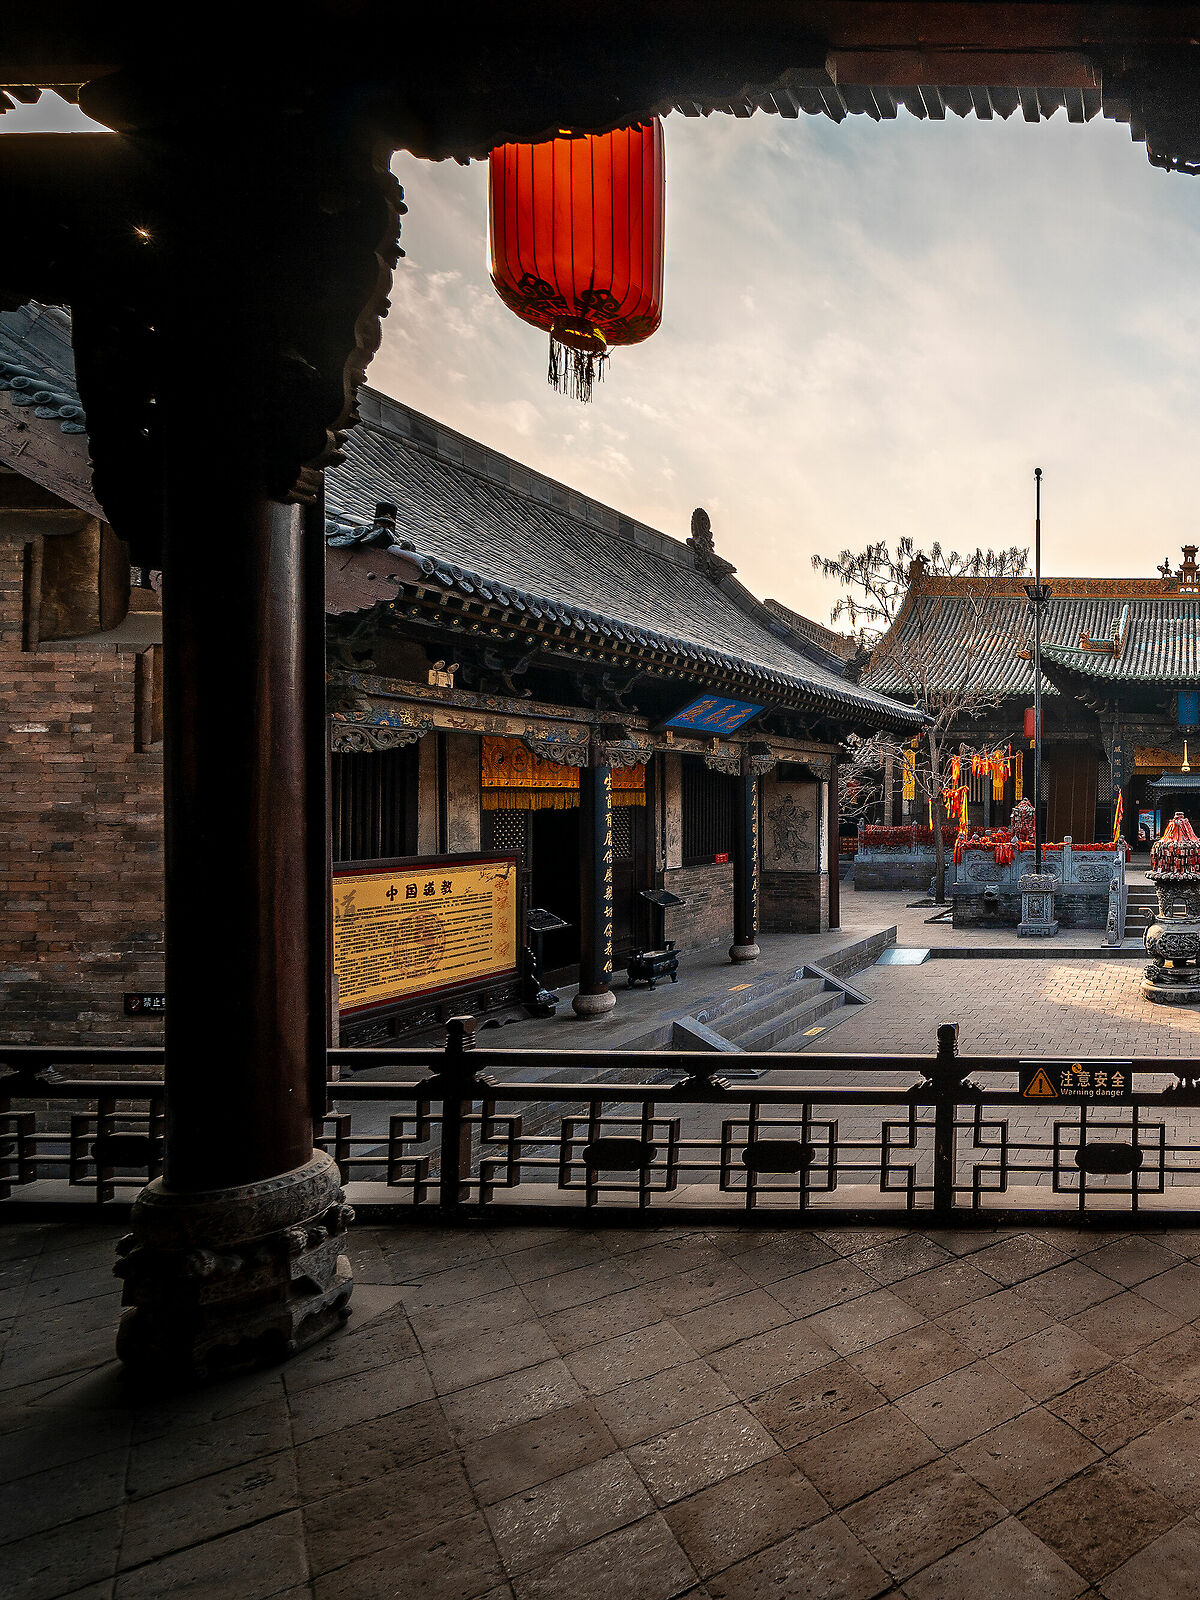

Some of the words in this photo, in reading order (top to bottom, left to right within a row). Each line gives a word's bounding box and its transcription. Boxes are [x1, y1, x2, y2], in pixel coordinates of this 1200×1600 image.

[386, 880, 453, 901] 中国道教
[1060, 1070, 1125, 1087] 注意安全
[1060, 1088, 1094, 1097] Warning
[1095, 1088, 1124, 1097] danger
